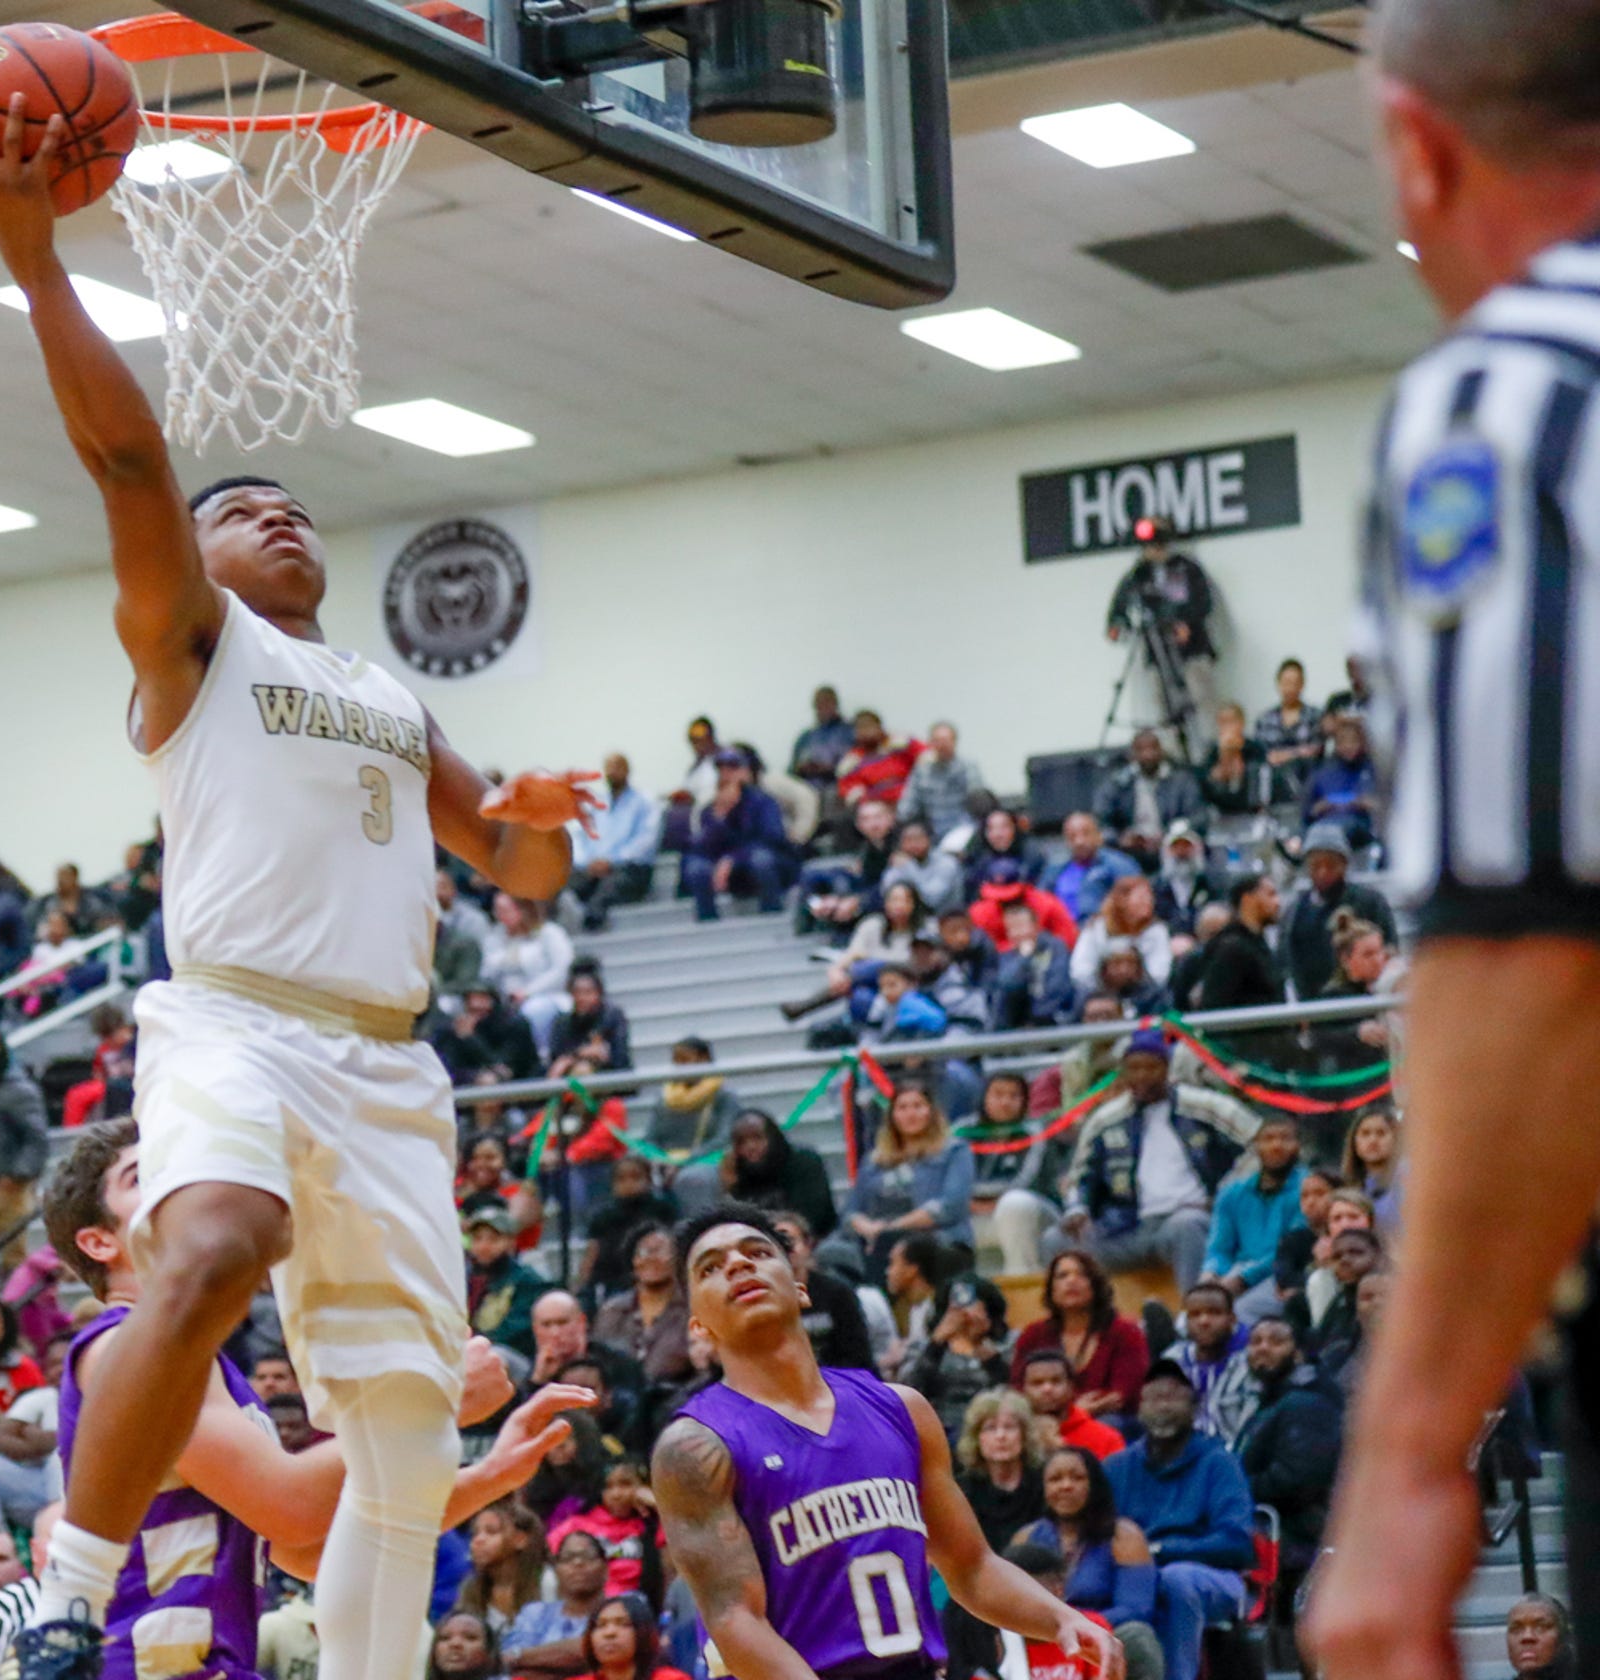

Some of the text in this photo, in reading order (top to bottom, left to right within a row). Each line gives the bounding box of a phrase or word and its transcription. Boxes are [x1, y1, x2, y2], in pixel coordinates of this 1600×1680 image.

[1070, 451, 1248, 548] HOME
[358, 764, 393, 846] 3
[848, 1551, 923, 1658] 0
